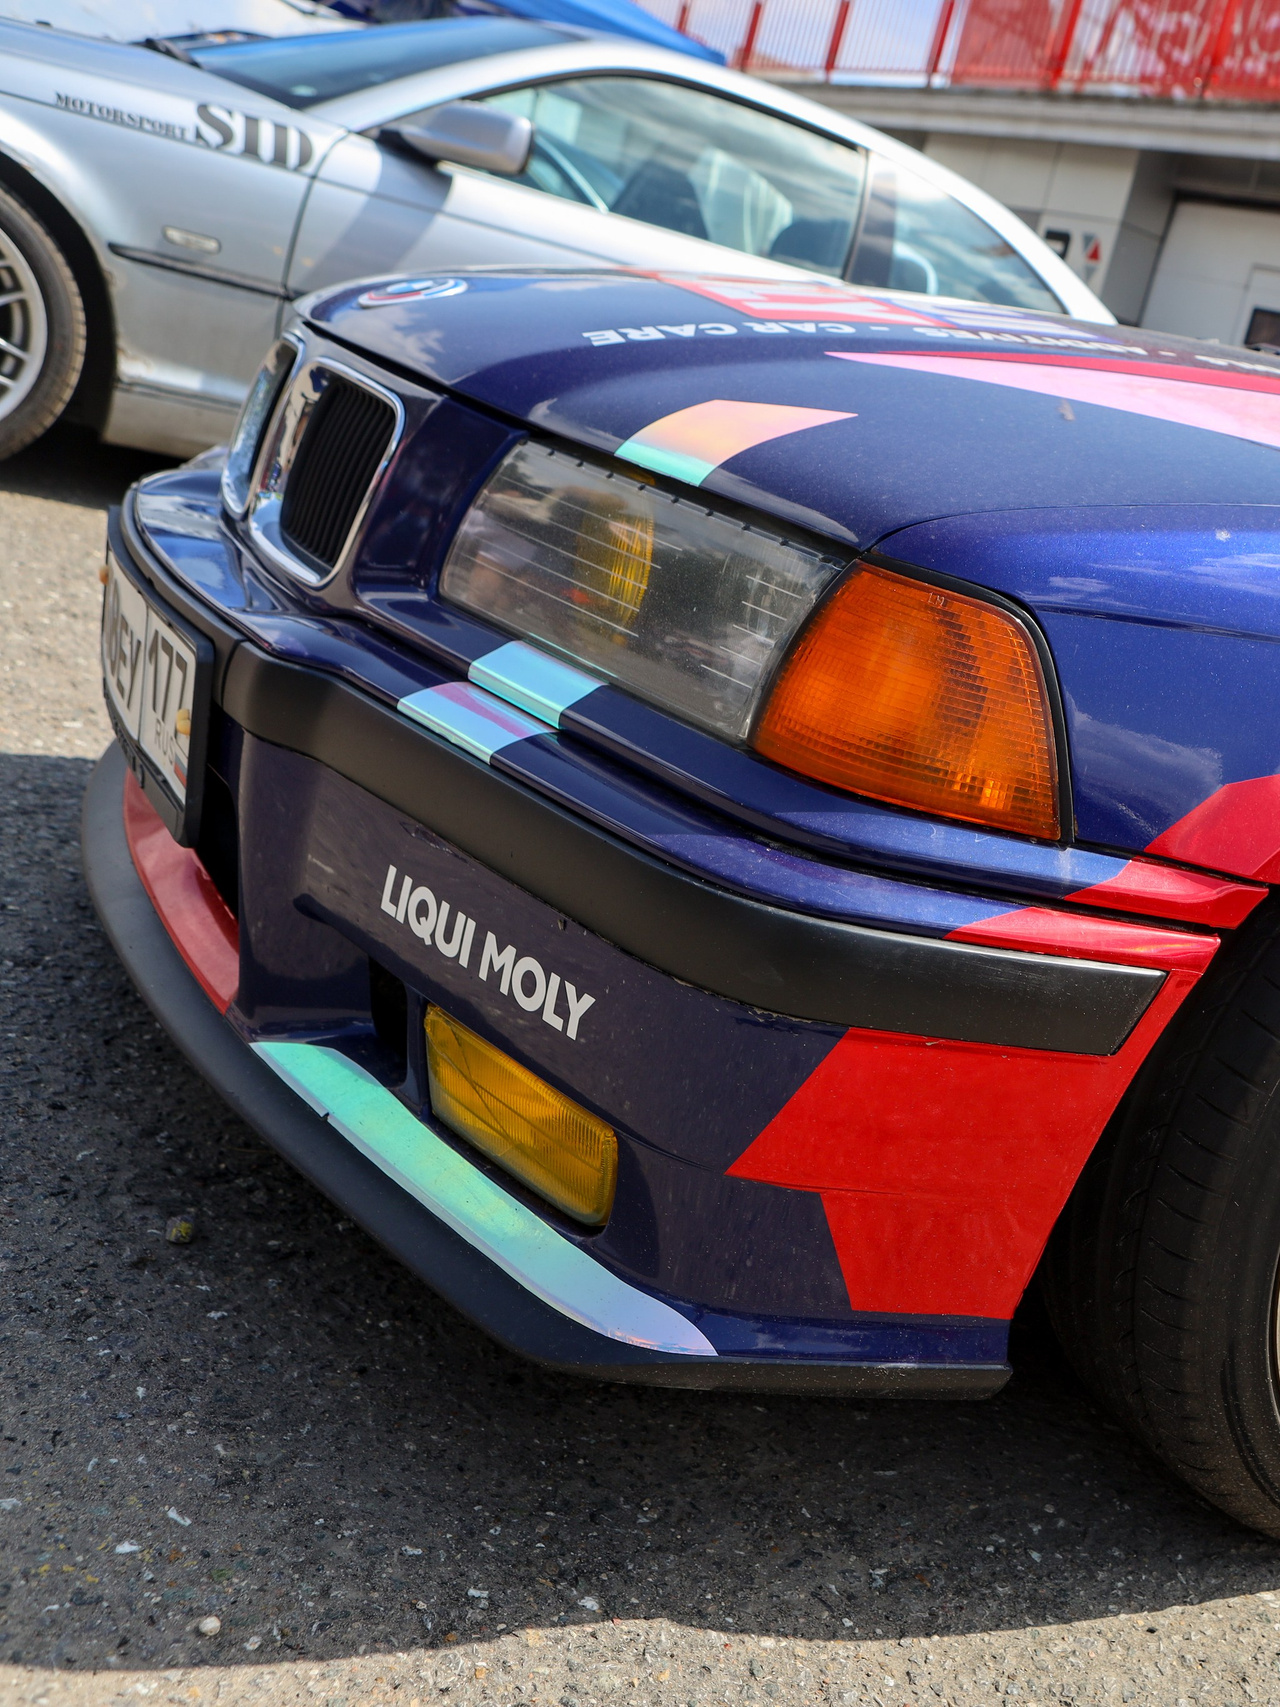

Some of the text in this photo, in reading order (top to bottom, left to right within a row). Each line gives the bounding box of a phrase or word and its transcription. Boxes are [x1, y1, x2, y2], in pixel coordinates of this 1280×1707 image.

[55, 91, 191, 138] MOTORSPORT
[582, 323, 738, 347] CARE
[742, 322, 857, 334] CAR
[149, 629, 188, 738] 177
[154, 717, 176, 766] RUS
[380, 864, 597, 1042] LIQUI MOLY
